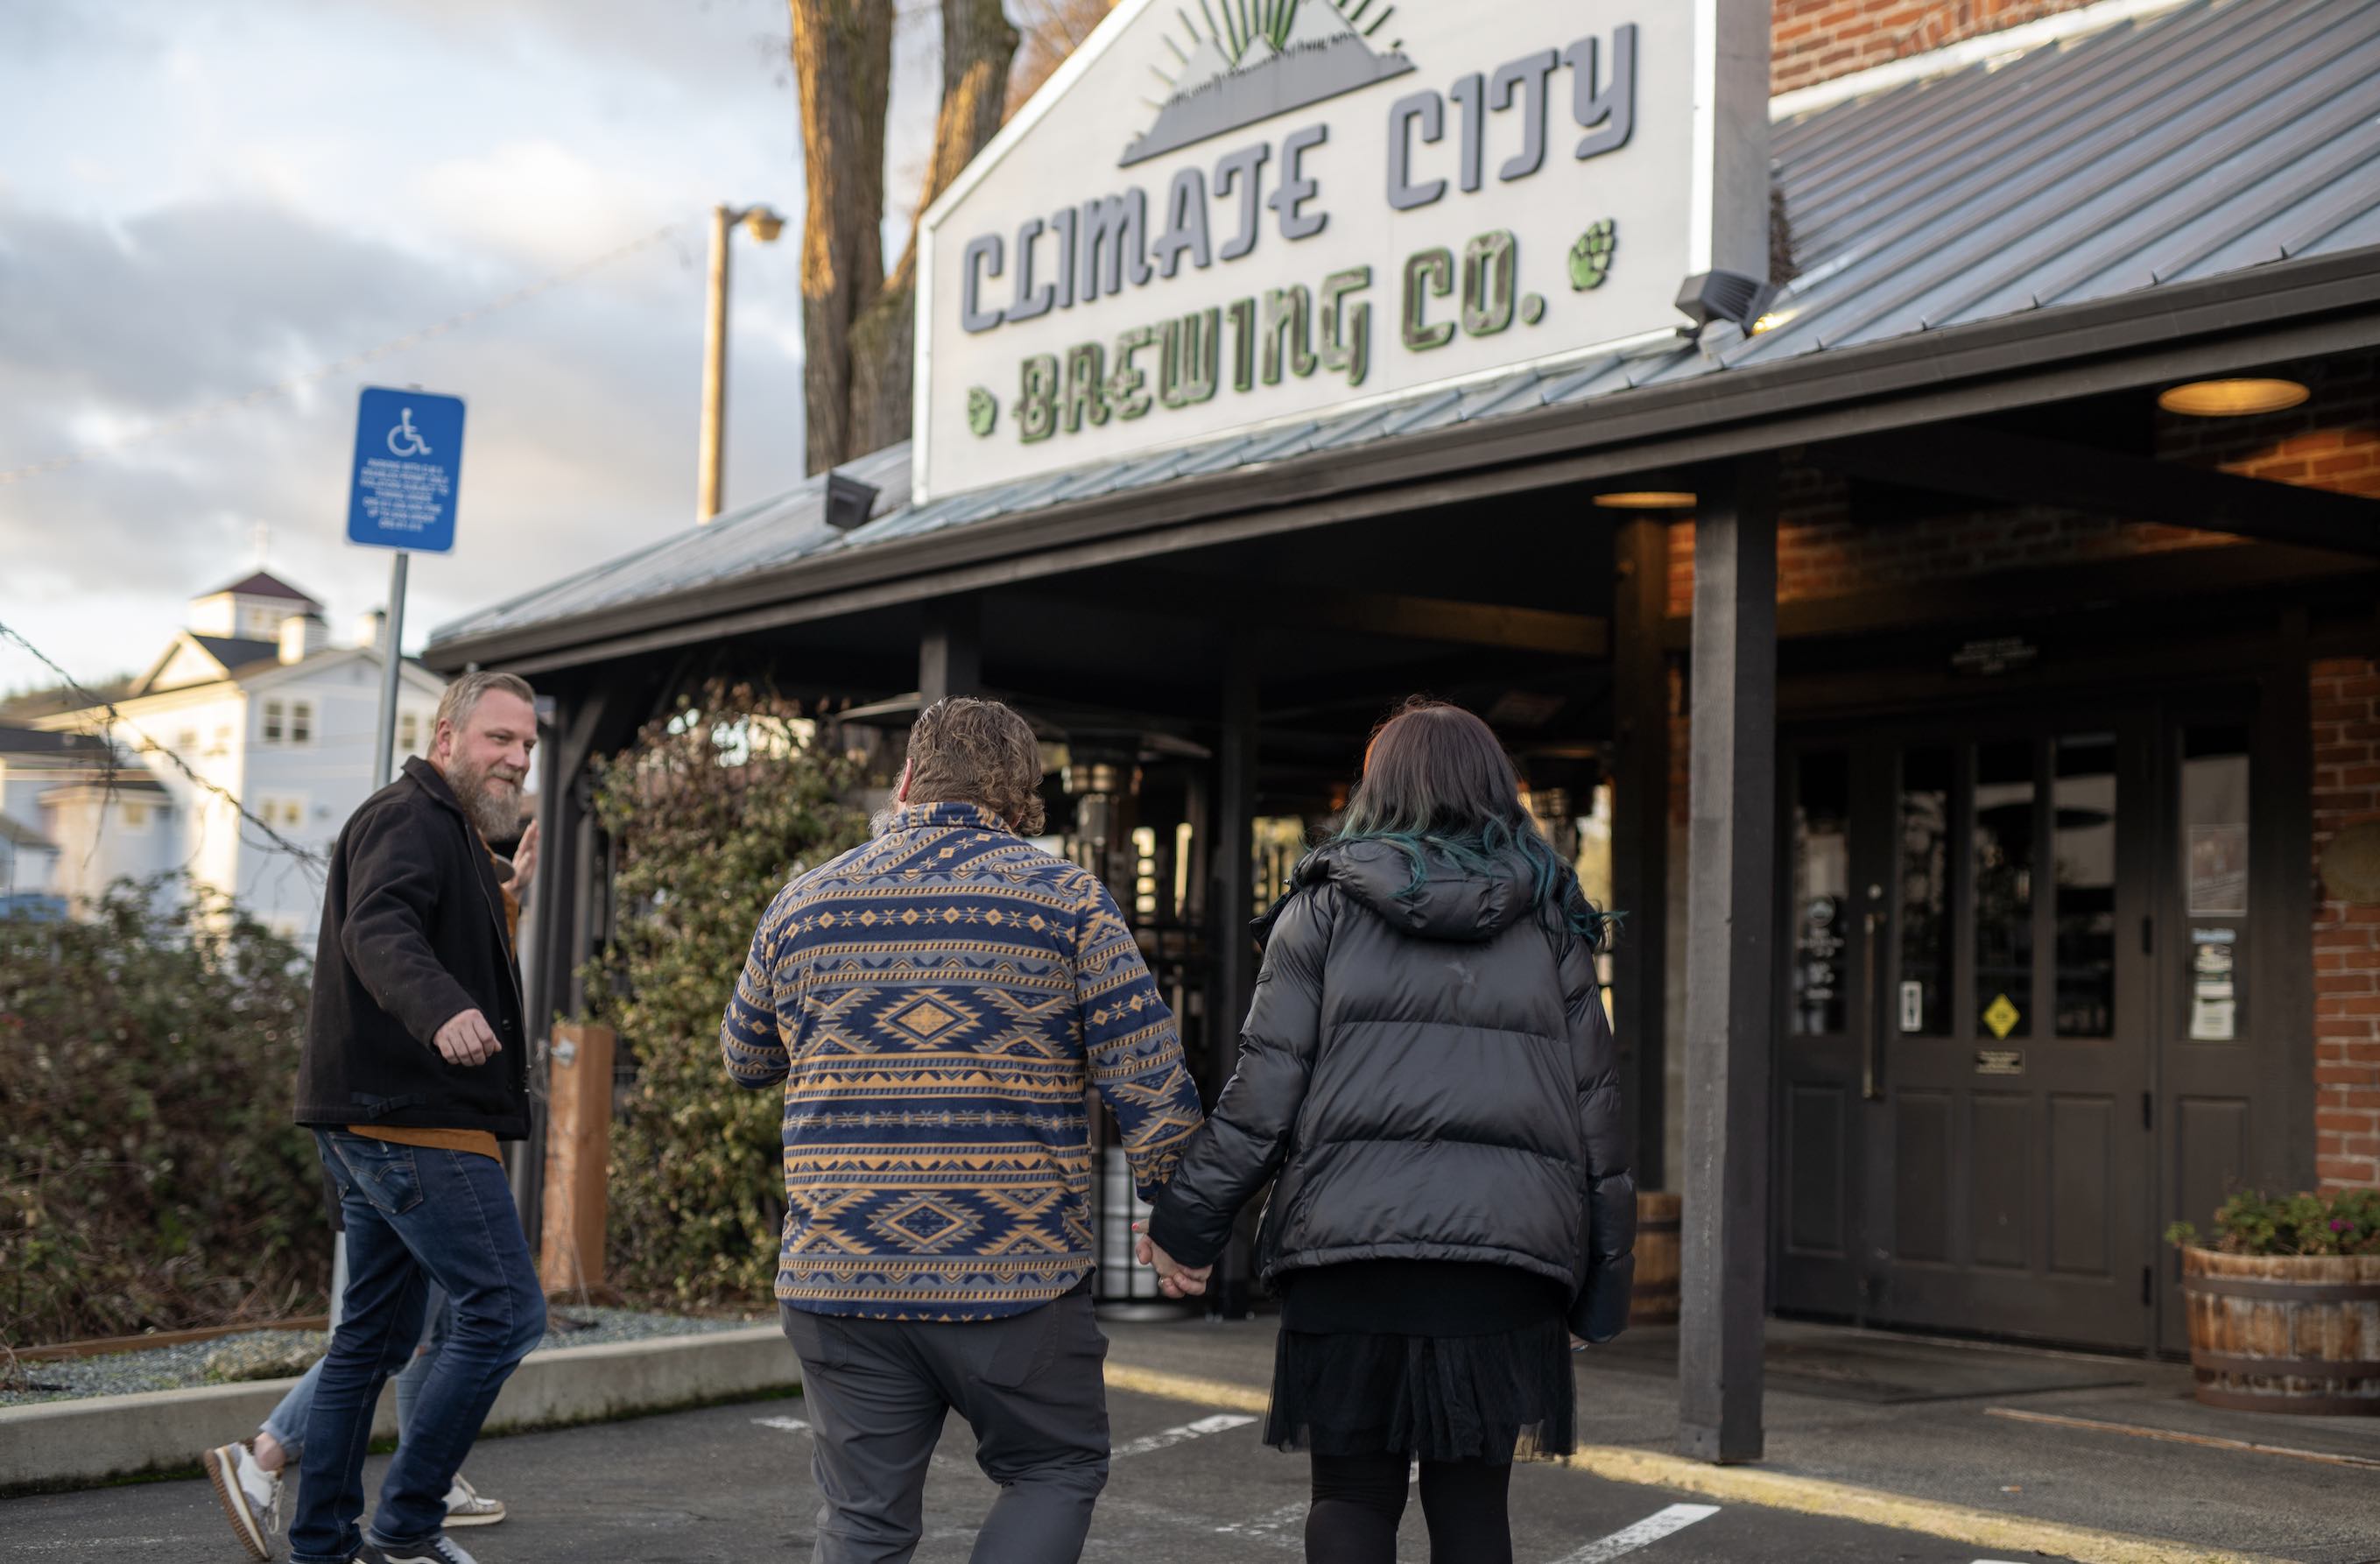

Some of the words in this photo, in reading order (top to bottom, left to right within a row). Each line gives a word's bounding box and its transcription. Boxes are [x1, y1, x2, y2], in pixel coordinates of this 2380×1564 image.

[961, 123, 1328, 333] CLIMATE
[1385, 22, 1637, 210] CITY
[1012, 265, 1372, 443] BREWING
[1402, 229, 1546, 351] CO.
